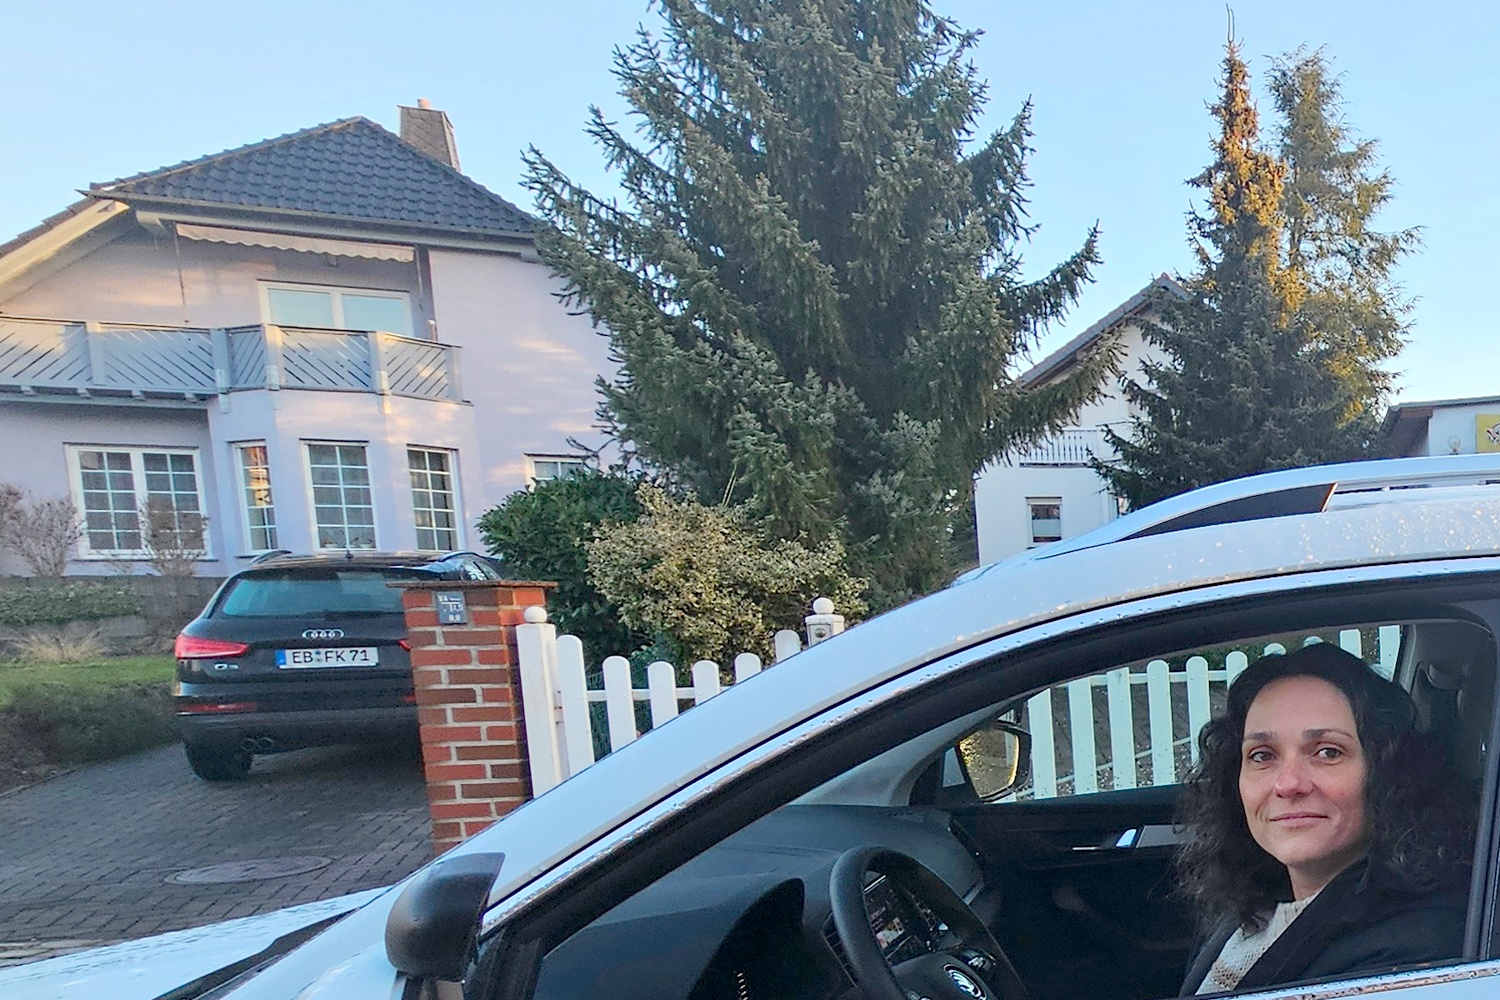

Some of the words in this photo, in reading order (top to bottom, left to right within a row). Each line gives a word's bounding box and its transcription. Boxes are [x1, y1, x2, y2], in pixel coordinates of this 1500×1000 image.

[292, 651, 313, 664] EB
[325, 650, 346, 663] FK
[350, 649, 370, 662] 71
